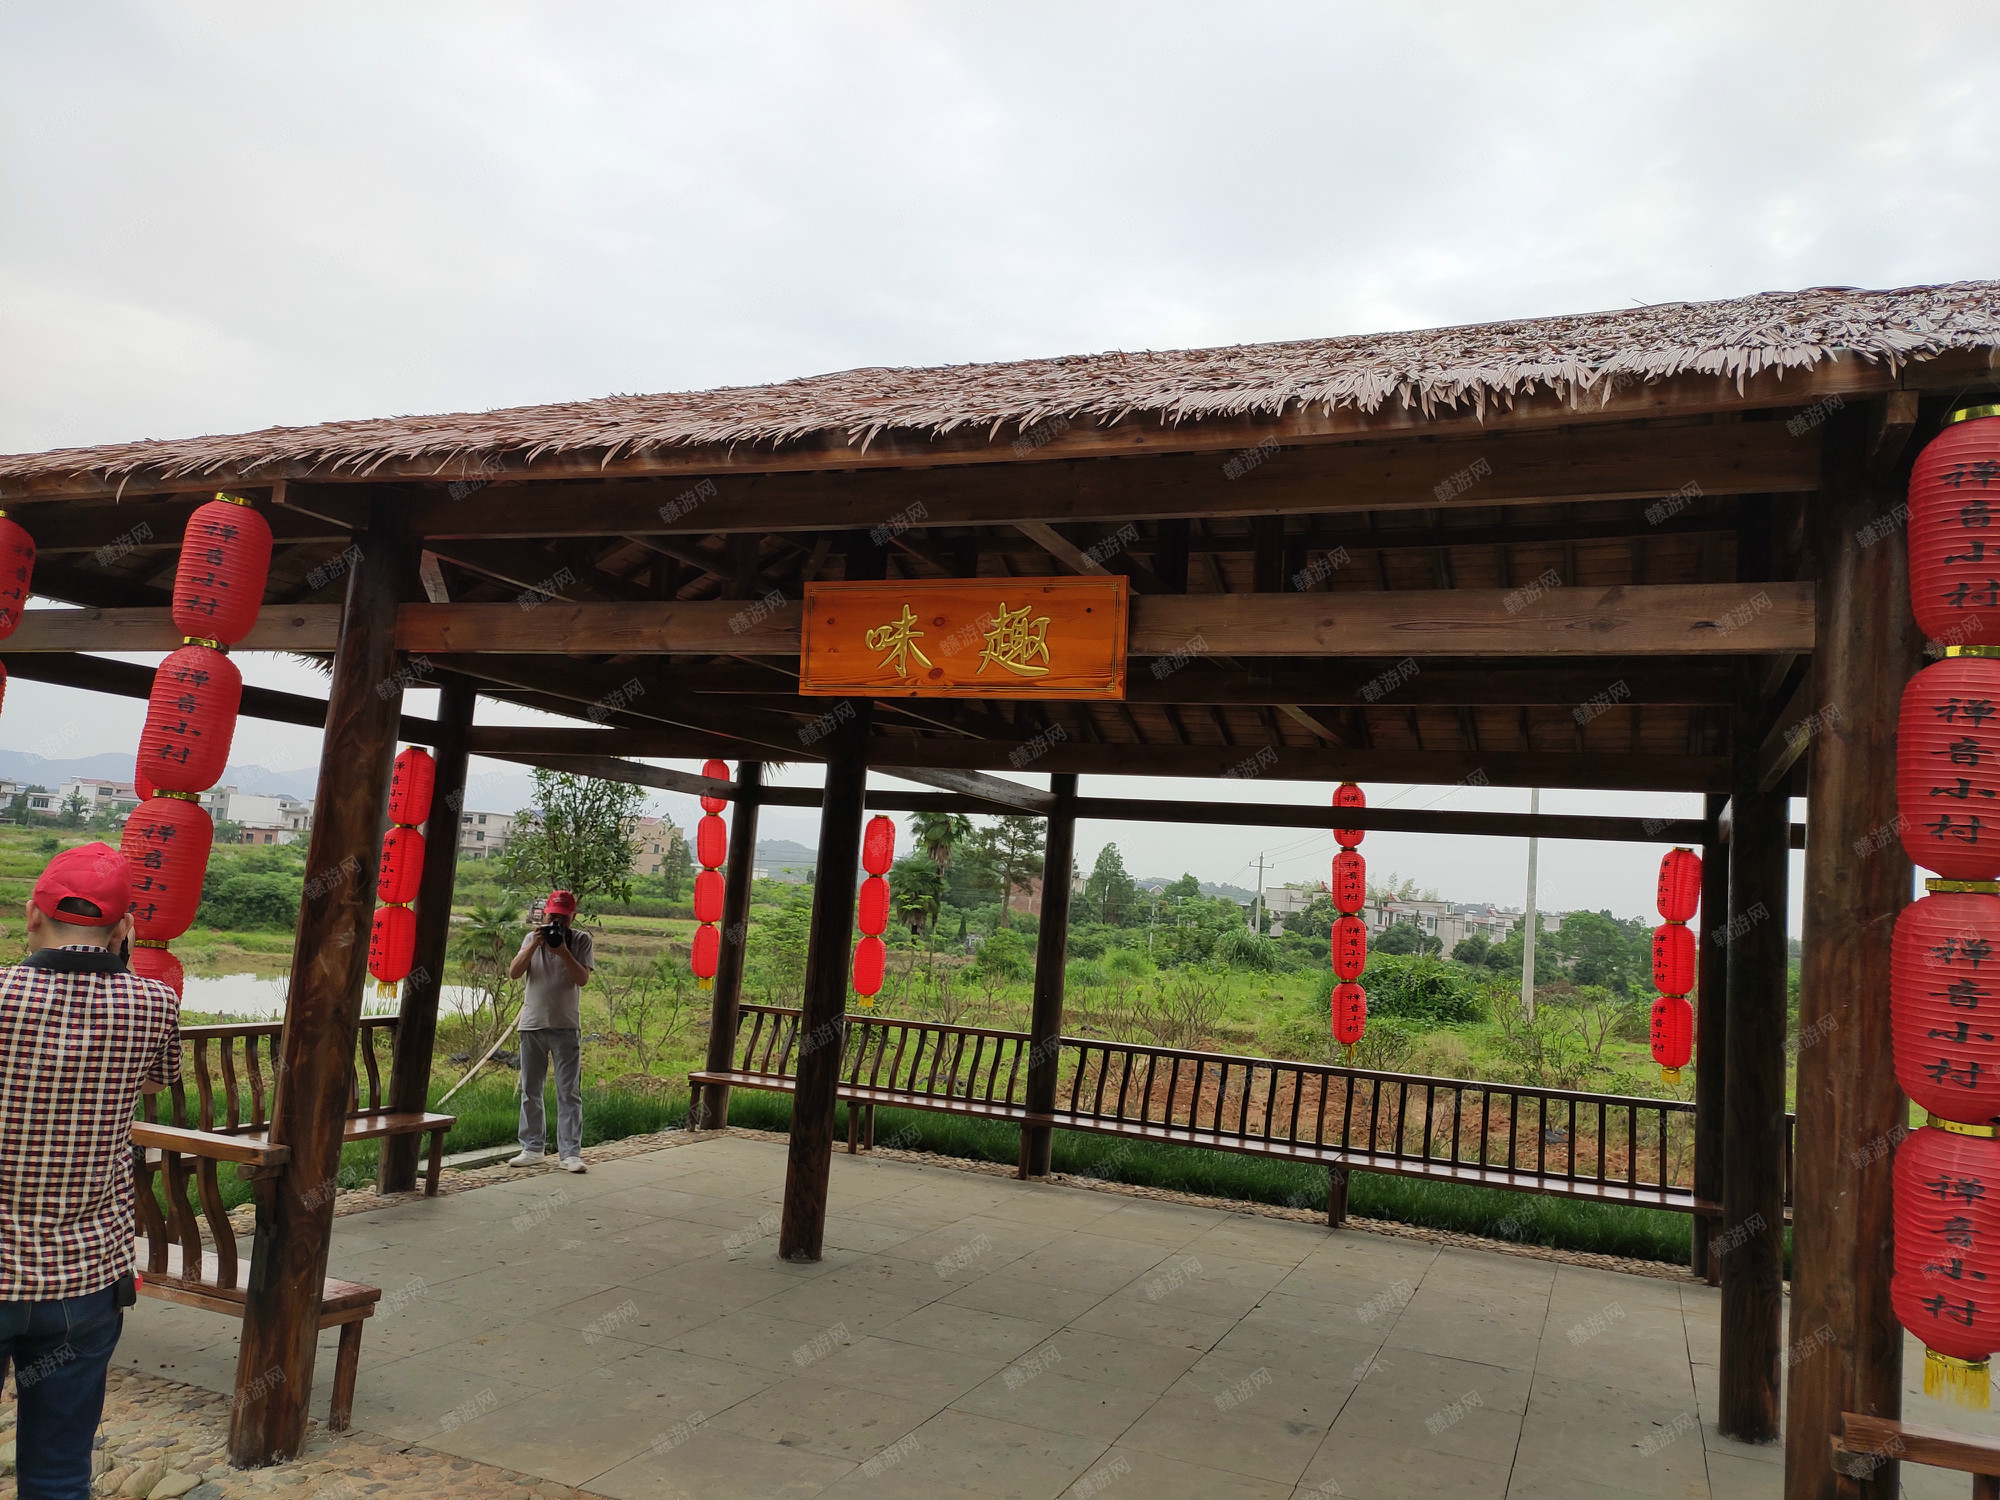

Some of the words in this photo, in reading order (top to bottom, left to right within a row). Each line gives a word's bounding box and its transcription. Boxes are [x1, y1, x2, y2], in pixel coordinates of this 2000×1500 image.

[186, 522, 239, 618] 禅音小村
[1939, 460, 2000, 609] 禅音小村
[157, 666, 210, 766] 禅音小村
[1923, 698, 1997, 845] 禅音小村
[1921, 938, 1995, 1090] 禅音小村
[1921, 1173, 1987, 1327] 禅音小村
